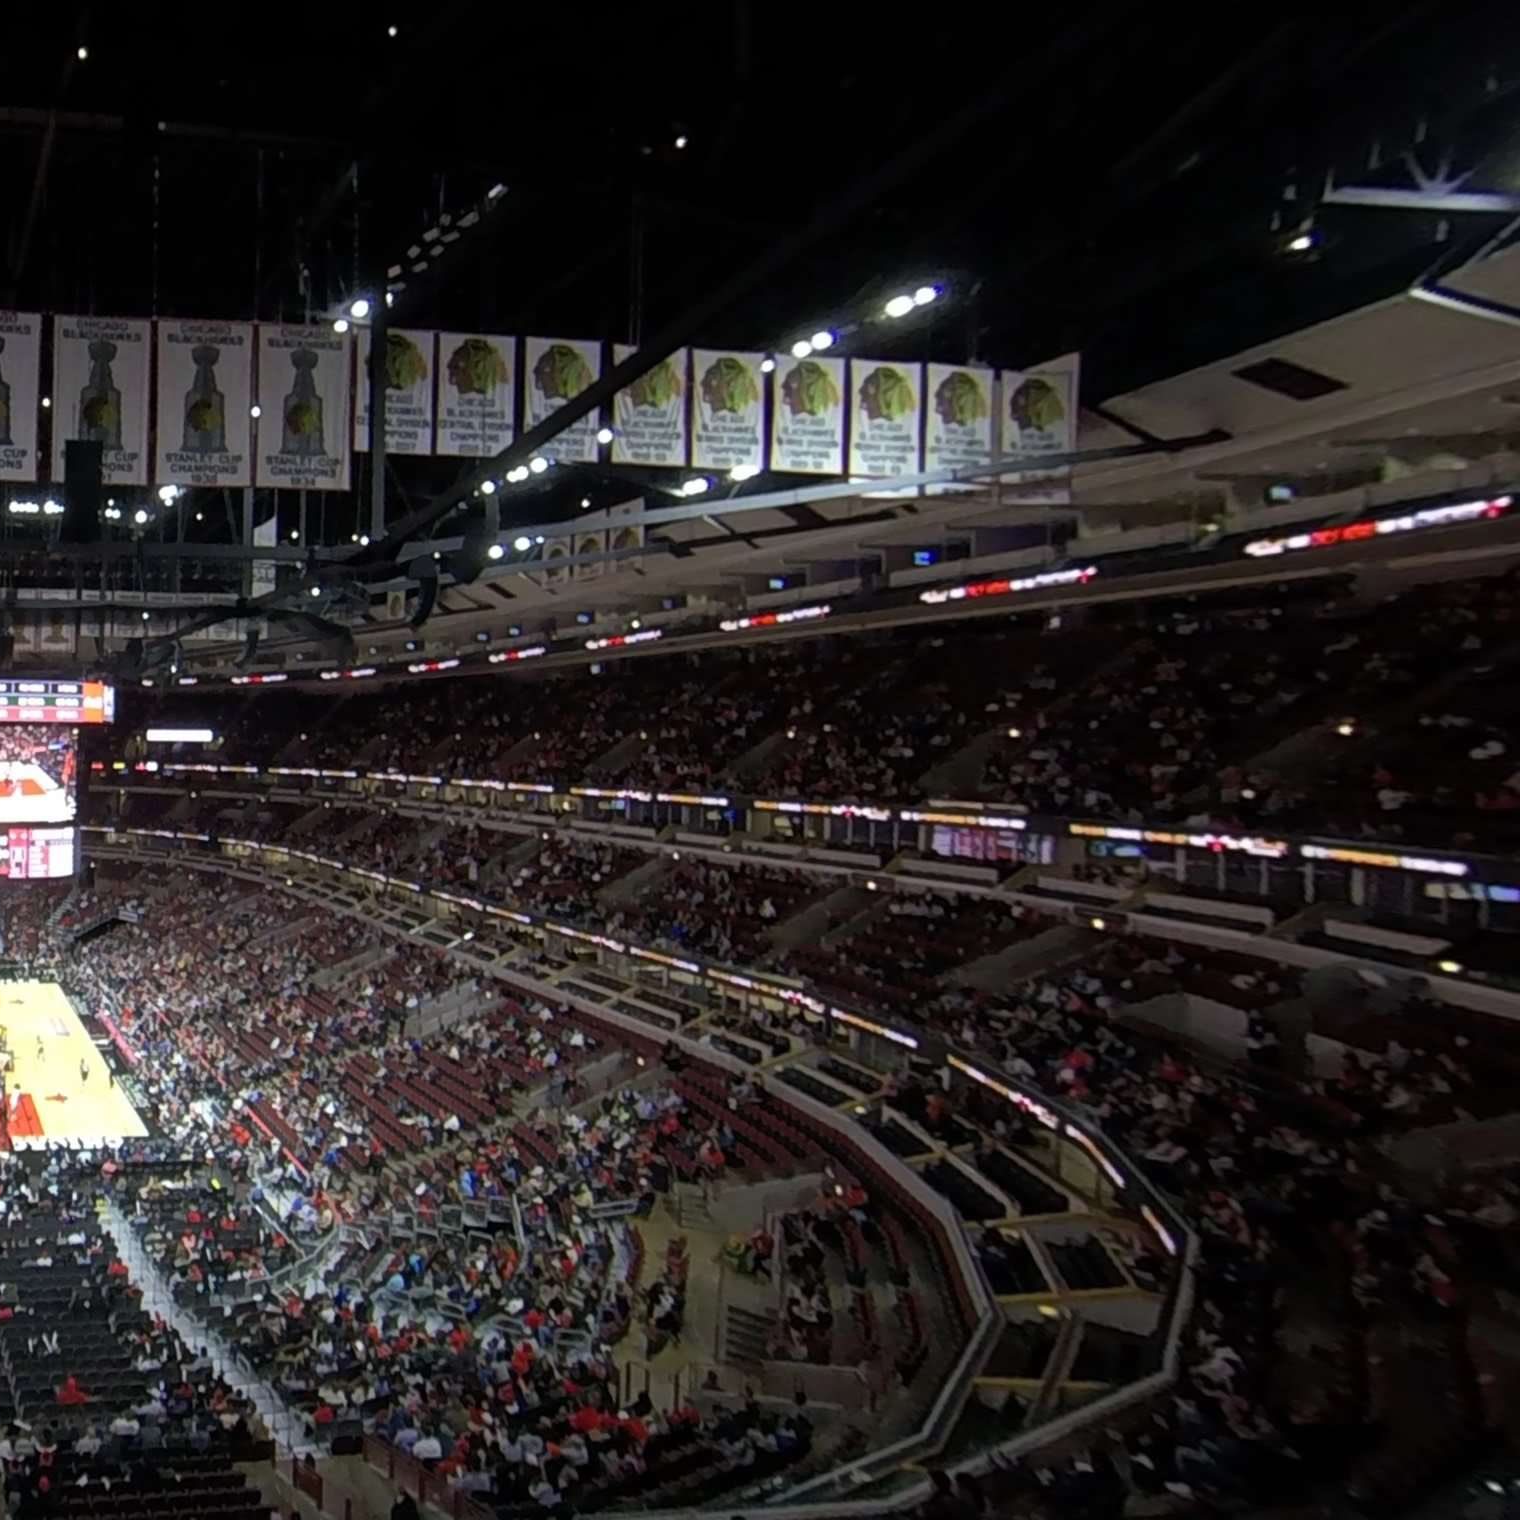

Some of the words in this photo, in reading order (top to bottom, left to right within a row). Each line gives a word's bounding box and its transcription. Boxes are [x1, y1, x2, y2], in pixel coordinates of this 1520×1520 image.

[76, 319, 129, 331] CHICAGO
[180, 324, 232, 336] CHICAGO
[63, 328, 141, 343] BLACKHAWKS
[281, 327, 329, 339] CHICAGO
[167, 333, 244, 347] BLACKHAWKS
[267, 338, 344, 352] BLACKHAWKS
[457, 396, 496, 407] CHICAGO
[446, 408, 506, 420] BLACKHAWKS
[450, 432, 500, 443] CHAMPIONS
[3, 447, 28, 459] CUP
[114, 451, 139, 463] CUP
[165, 452, 214, 465] STANLEY
[218, 454, 243, 466] CUP
[265, 454, 312, 467] STANLEY
[316, 457, 341, 468] CUP
[170, 463, 238, 476] CHAMPIONS
[270, 466, 337, 478] CHAMPIONS
